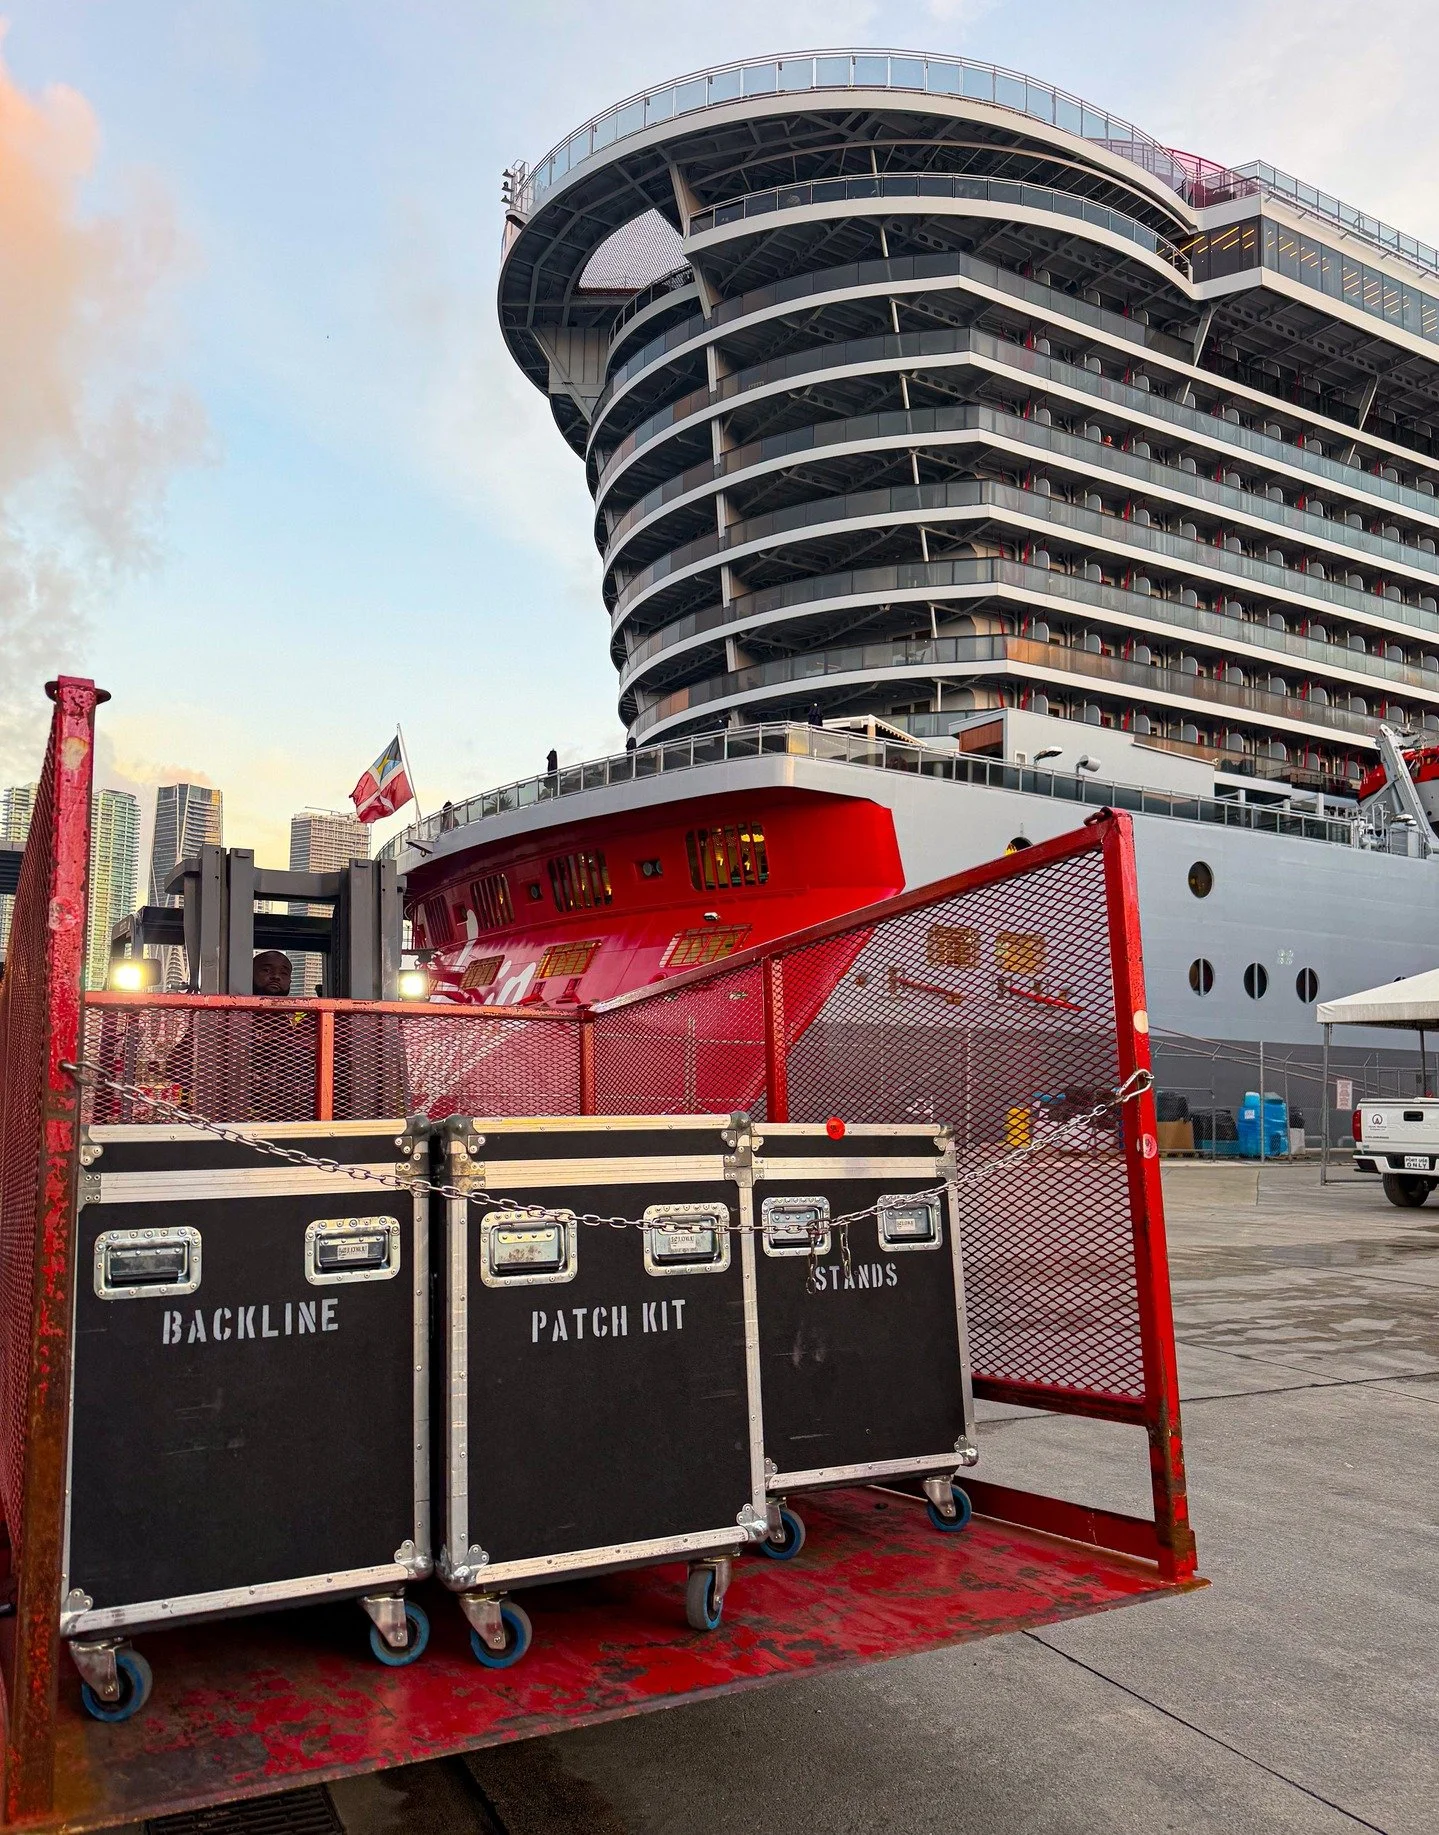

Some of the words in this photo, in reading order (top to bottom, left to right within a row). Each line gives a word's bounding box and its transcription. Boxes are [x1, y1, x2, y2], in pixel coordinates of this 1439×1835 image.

[815, 1262, 898, 1291] STANDS
[162, 1298, 339, 1345] BACKLINE
[531, 1306, 628, 1343] PATCH
[642, 1299, 686, 1334] KIT
